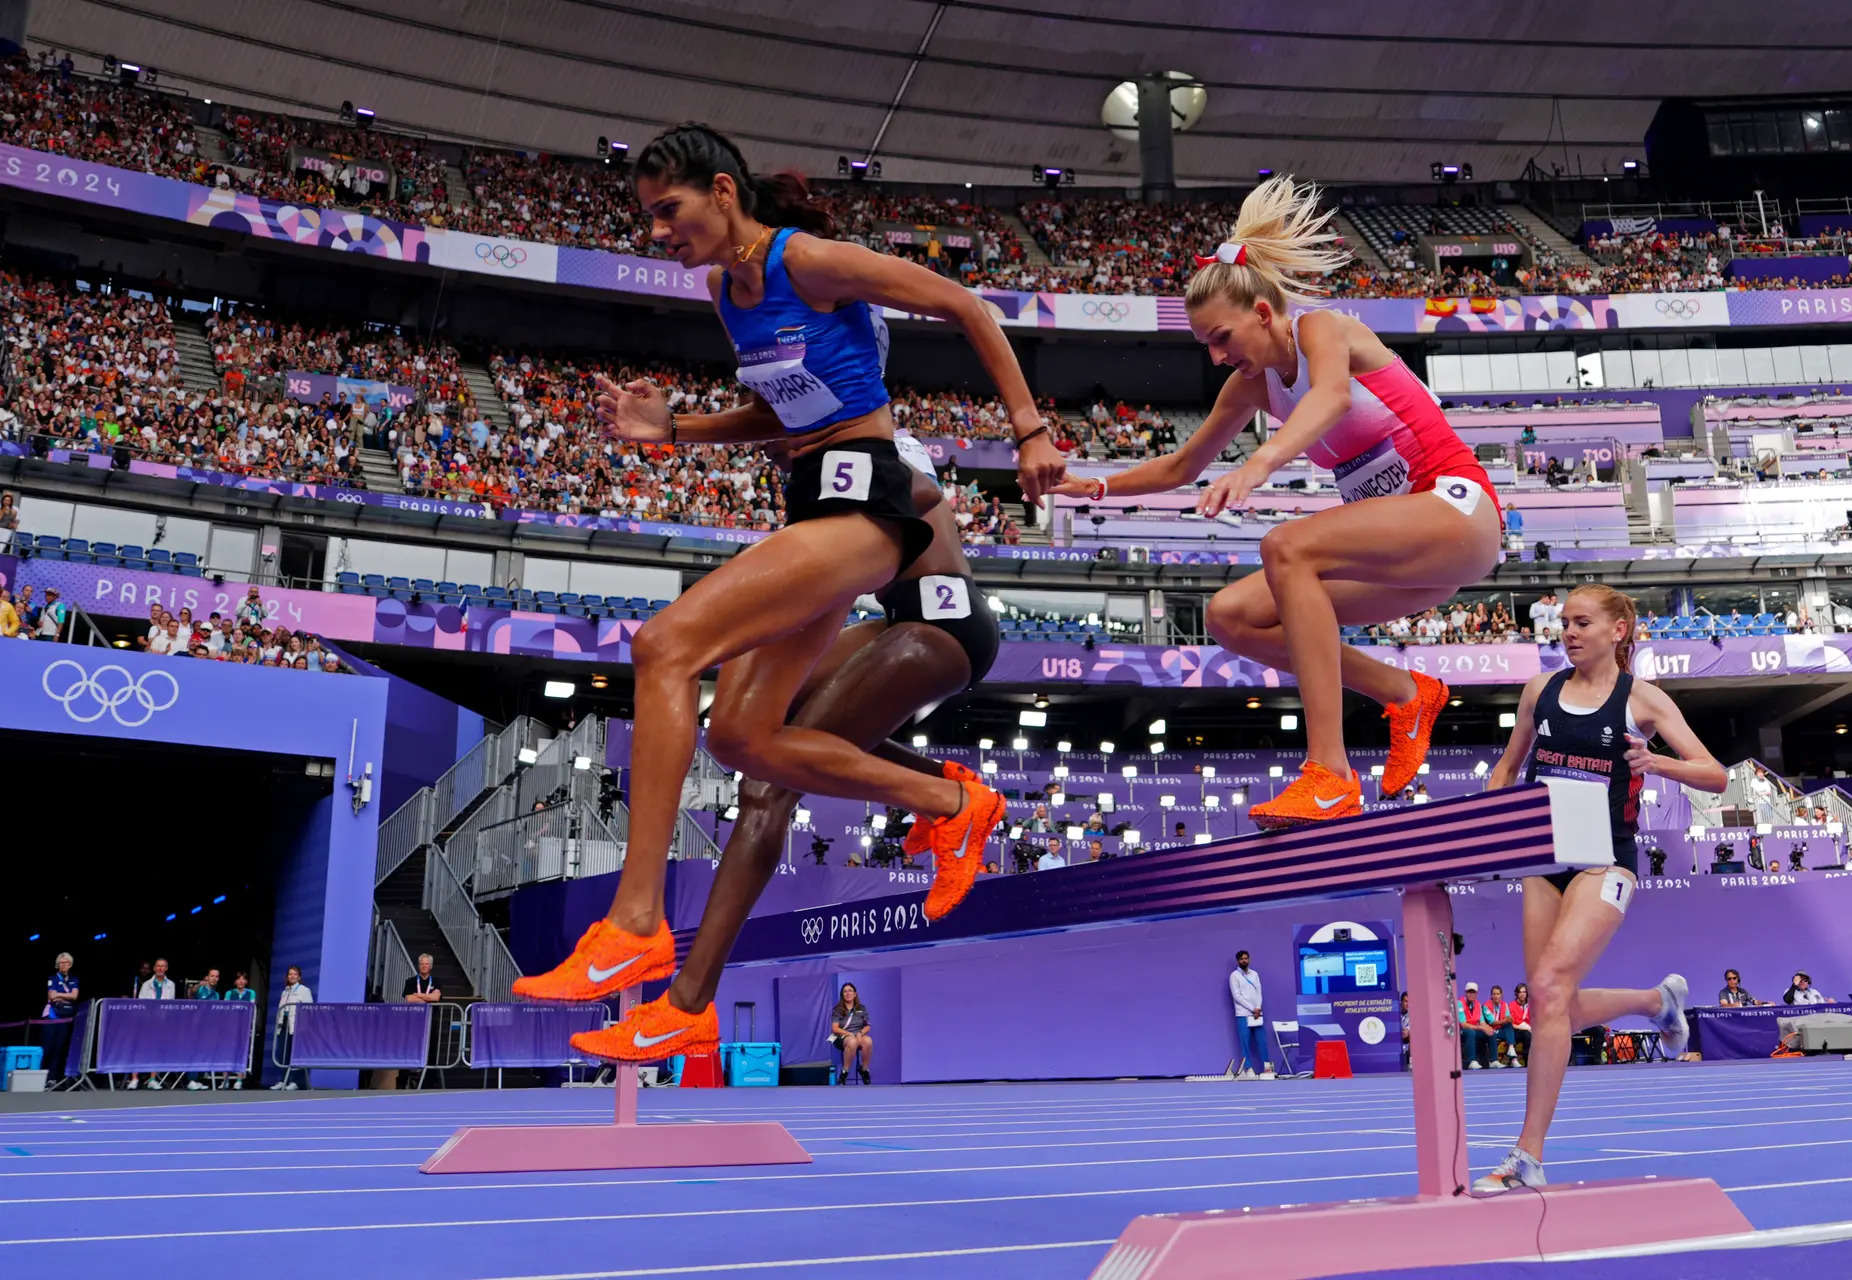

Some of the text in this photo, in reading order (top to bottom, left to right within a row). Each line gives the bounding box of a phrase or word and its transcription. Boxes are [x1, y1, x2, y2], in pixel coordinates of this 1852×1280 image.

[36, 163, 120, 197] 2024
[1493, 243, 1517, 255] U19
[617, 264, 695, 289] PARIS
[1781, 297, 1852, 315] PARIS
[287, 378, 311, 396] X5
[1524, 450, 1546, 464] T11
[1583, 448, 1612, 462] T10
[832, 461, 854, 493] 5
[1012, 550, 1056, 560] PARIS
[96, 579, 302, 622] PARIS 224
[935, 584, 957, 610] 2
[1438, 654, 1510, 674] 2024
[1654, 653, 1691, 675] U17
[1751, 650, 1782, 671] U9
[1042, 657, 1082, 678] U18
[1203, 752, 1256, 760] PARIS 2024
[1276, 751, 1303, 759] PARIS
[1350, 750, 1376, 758] PARIS
[1449, 749, 1473, 757] 2024
[1536, 748, 1614, 773] GREAT BRITAIN
[1001, 773, 1028, 781] 2024
[1079, 776, 1105, 784] 2024
[1155, 777, 1182, 785] 2024
[1203, 776, 1261, 784] PARIS 2024
[1438, 773, 1467, 781] PARIS
[792, 822, 816, 833] 024
[1776, 829, 1809, 839] PARIS
[1634, 834, 1658, 844] 024
[1720, 831, 1750, 841] 2024
[888, 871, 929, 884] PARIS
[1656, 878, 1691, 889] 2024
[1720, 874, 1796, 887] PARIS 2024
[1446, 884, 1476, 895] 024
[1616, 882, 1624, 902] 1
[830, 902, 930, 940] PARIS 2024
